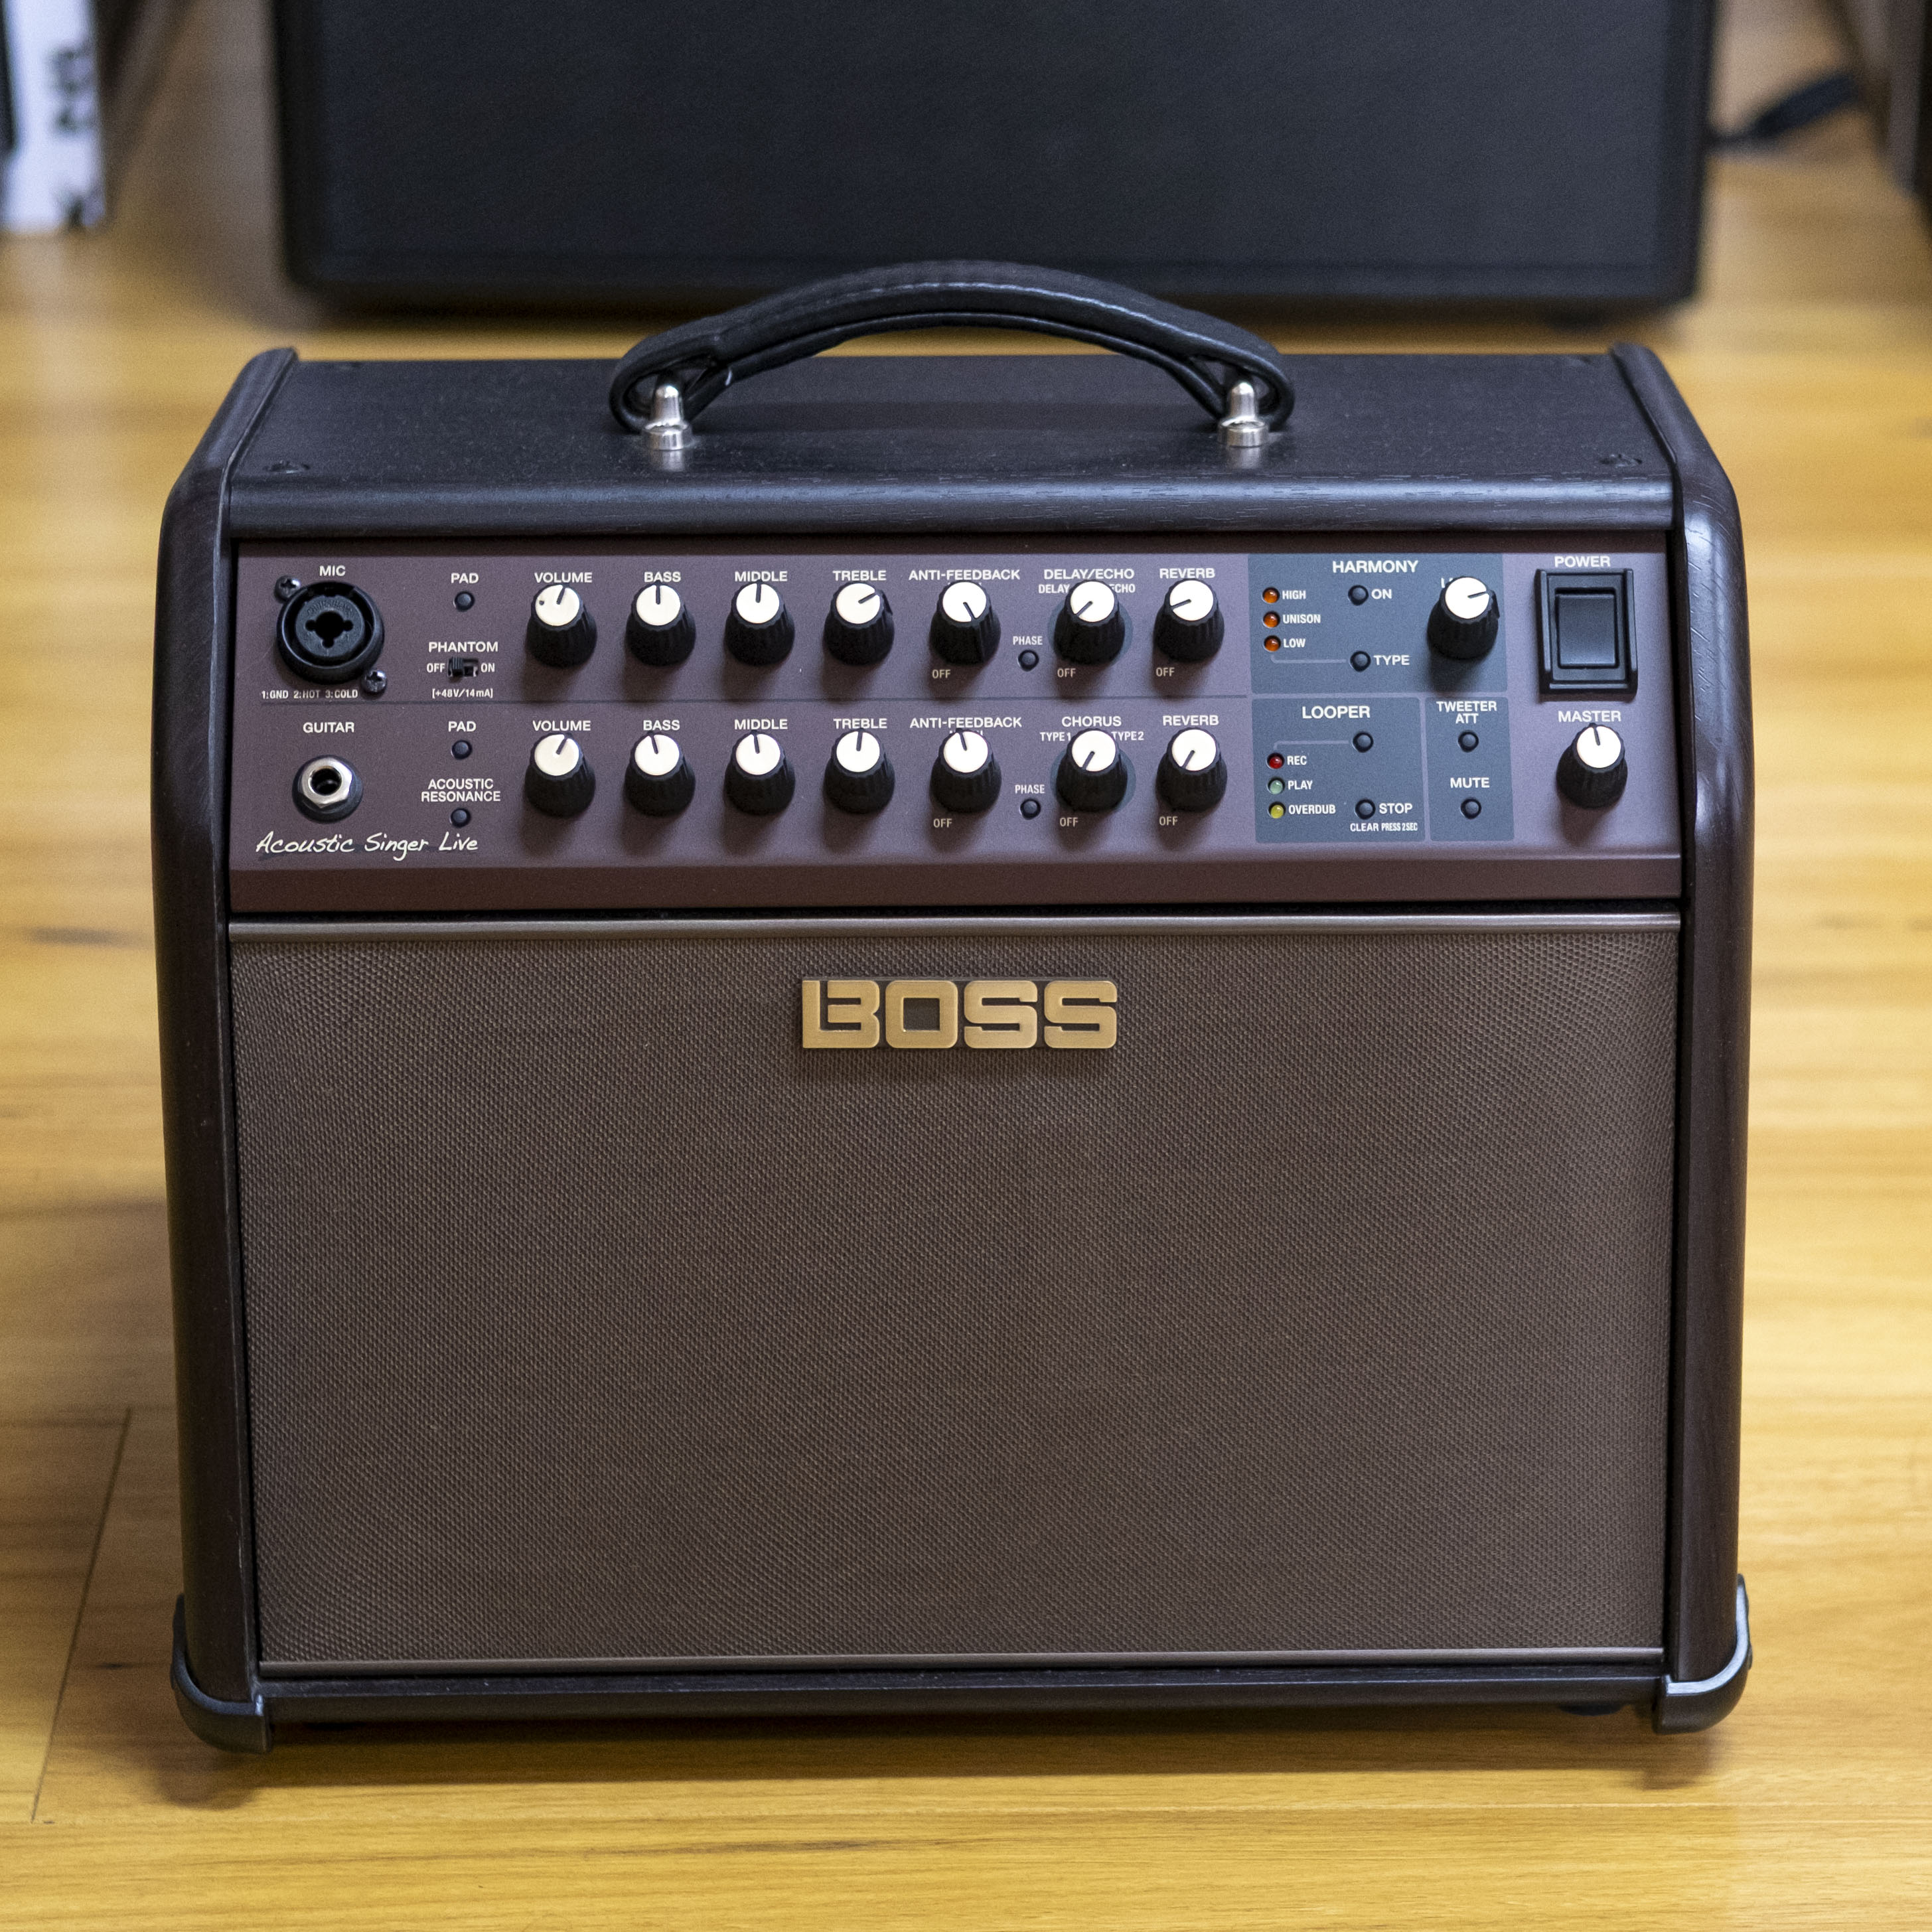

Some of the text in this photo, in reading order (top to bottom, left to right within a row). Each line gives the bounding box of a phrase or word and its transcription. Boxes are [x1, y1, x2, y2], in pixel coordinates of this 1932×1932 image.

[1332, 560, 1419, 573] HARMONY
[1554, 556, 1611, 568] POWER
[319, 565, 346, 577] MIC
[534, 571, 593, 583] VOLUME
[644, 571, 682, 583] BASS
[734, 570, 788, 582] MIDDLE
[832, 569, 887, 581] TREBLE
[909, 569, 1021, 581] ANTI-FEEDBACK
[1044, 568, 1135, 580] DELAY/ECHO
[1159, 567, 1216, 579] REVERB
[451, 573, 479, 584] PAD
[1038, 583, 1071, 594] DELAY
[1282, 589, 1306, 600] HIGH
[1371, 589, 1392, 600] ON
[1282, 614, 1321, 625] UNISON
[428, 640, 498, 653] PHANTOM
[1012, 635, 1043, 646] PHASE
[1283, 638, 1306, 648] LOW
[1373, 654, 1410, 666] TYPE
[426, 662, 446, 673] OFF
[480, 662, 496, 673] ON
[932, 668, 951, 679] OFF
[1057, 668, 1077, 678] OFF
[1155, 667, 1175, 677] OFF
[261, 689, 289, 700] 1:GND
[293, 689, 321, 700] 2:HOT
[1301, 706, 1371, 719] LOOPER
[1436, 700, 1498, 713] TWEETER
[1061, 715, 1122, 727] CHORUS
[1162, 714, 1220, 727] REVERB
[1455, 712, 1479, 725] ATT
[1557, 710, 1622, 723] MASTER
[303, 721, 355, 733] GUITAR
[448, 720, 477, 732] PAD
[532, 719, 591, 731] VOLUME
[642, 719, 681, 731] BASS
[734, 719, 788, 731] MIDDLE
[833, 717, 888, 729] TREBLE
[909, 717, 1022, 729] ANTI-FEEDBACK
[1286, 755, 1307, 766] REC
[427, 778, 494, 790] ACOUSTIC
[1015, 784, 1045, 794] PHASE
[1287, 779, 1314, 790] PLAY
[1449, 777, 1491, 789] MUTE
[421, 790, 501, 802] RESONANCE
[1288, 804, 1337, 816] OVERDUB
[1378, 802, 1413, 814] STOP
[933, 818, 953, 828] OFF
[1059, 817, 1079, 827] OFF
[1159, 816, 1179, 826] OFF
[1349, 822, 1380, 832] CLEAR
[1380, 822, 1401, 832] PRESS
[256, 830, 479, 861] Acoustic Singer Live
[802, 980, 1118, 1049] BOSS
